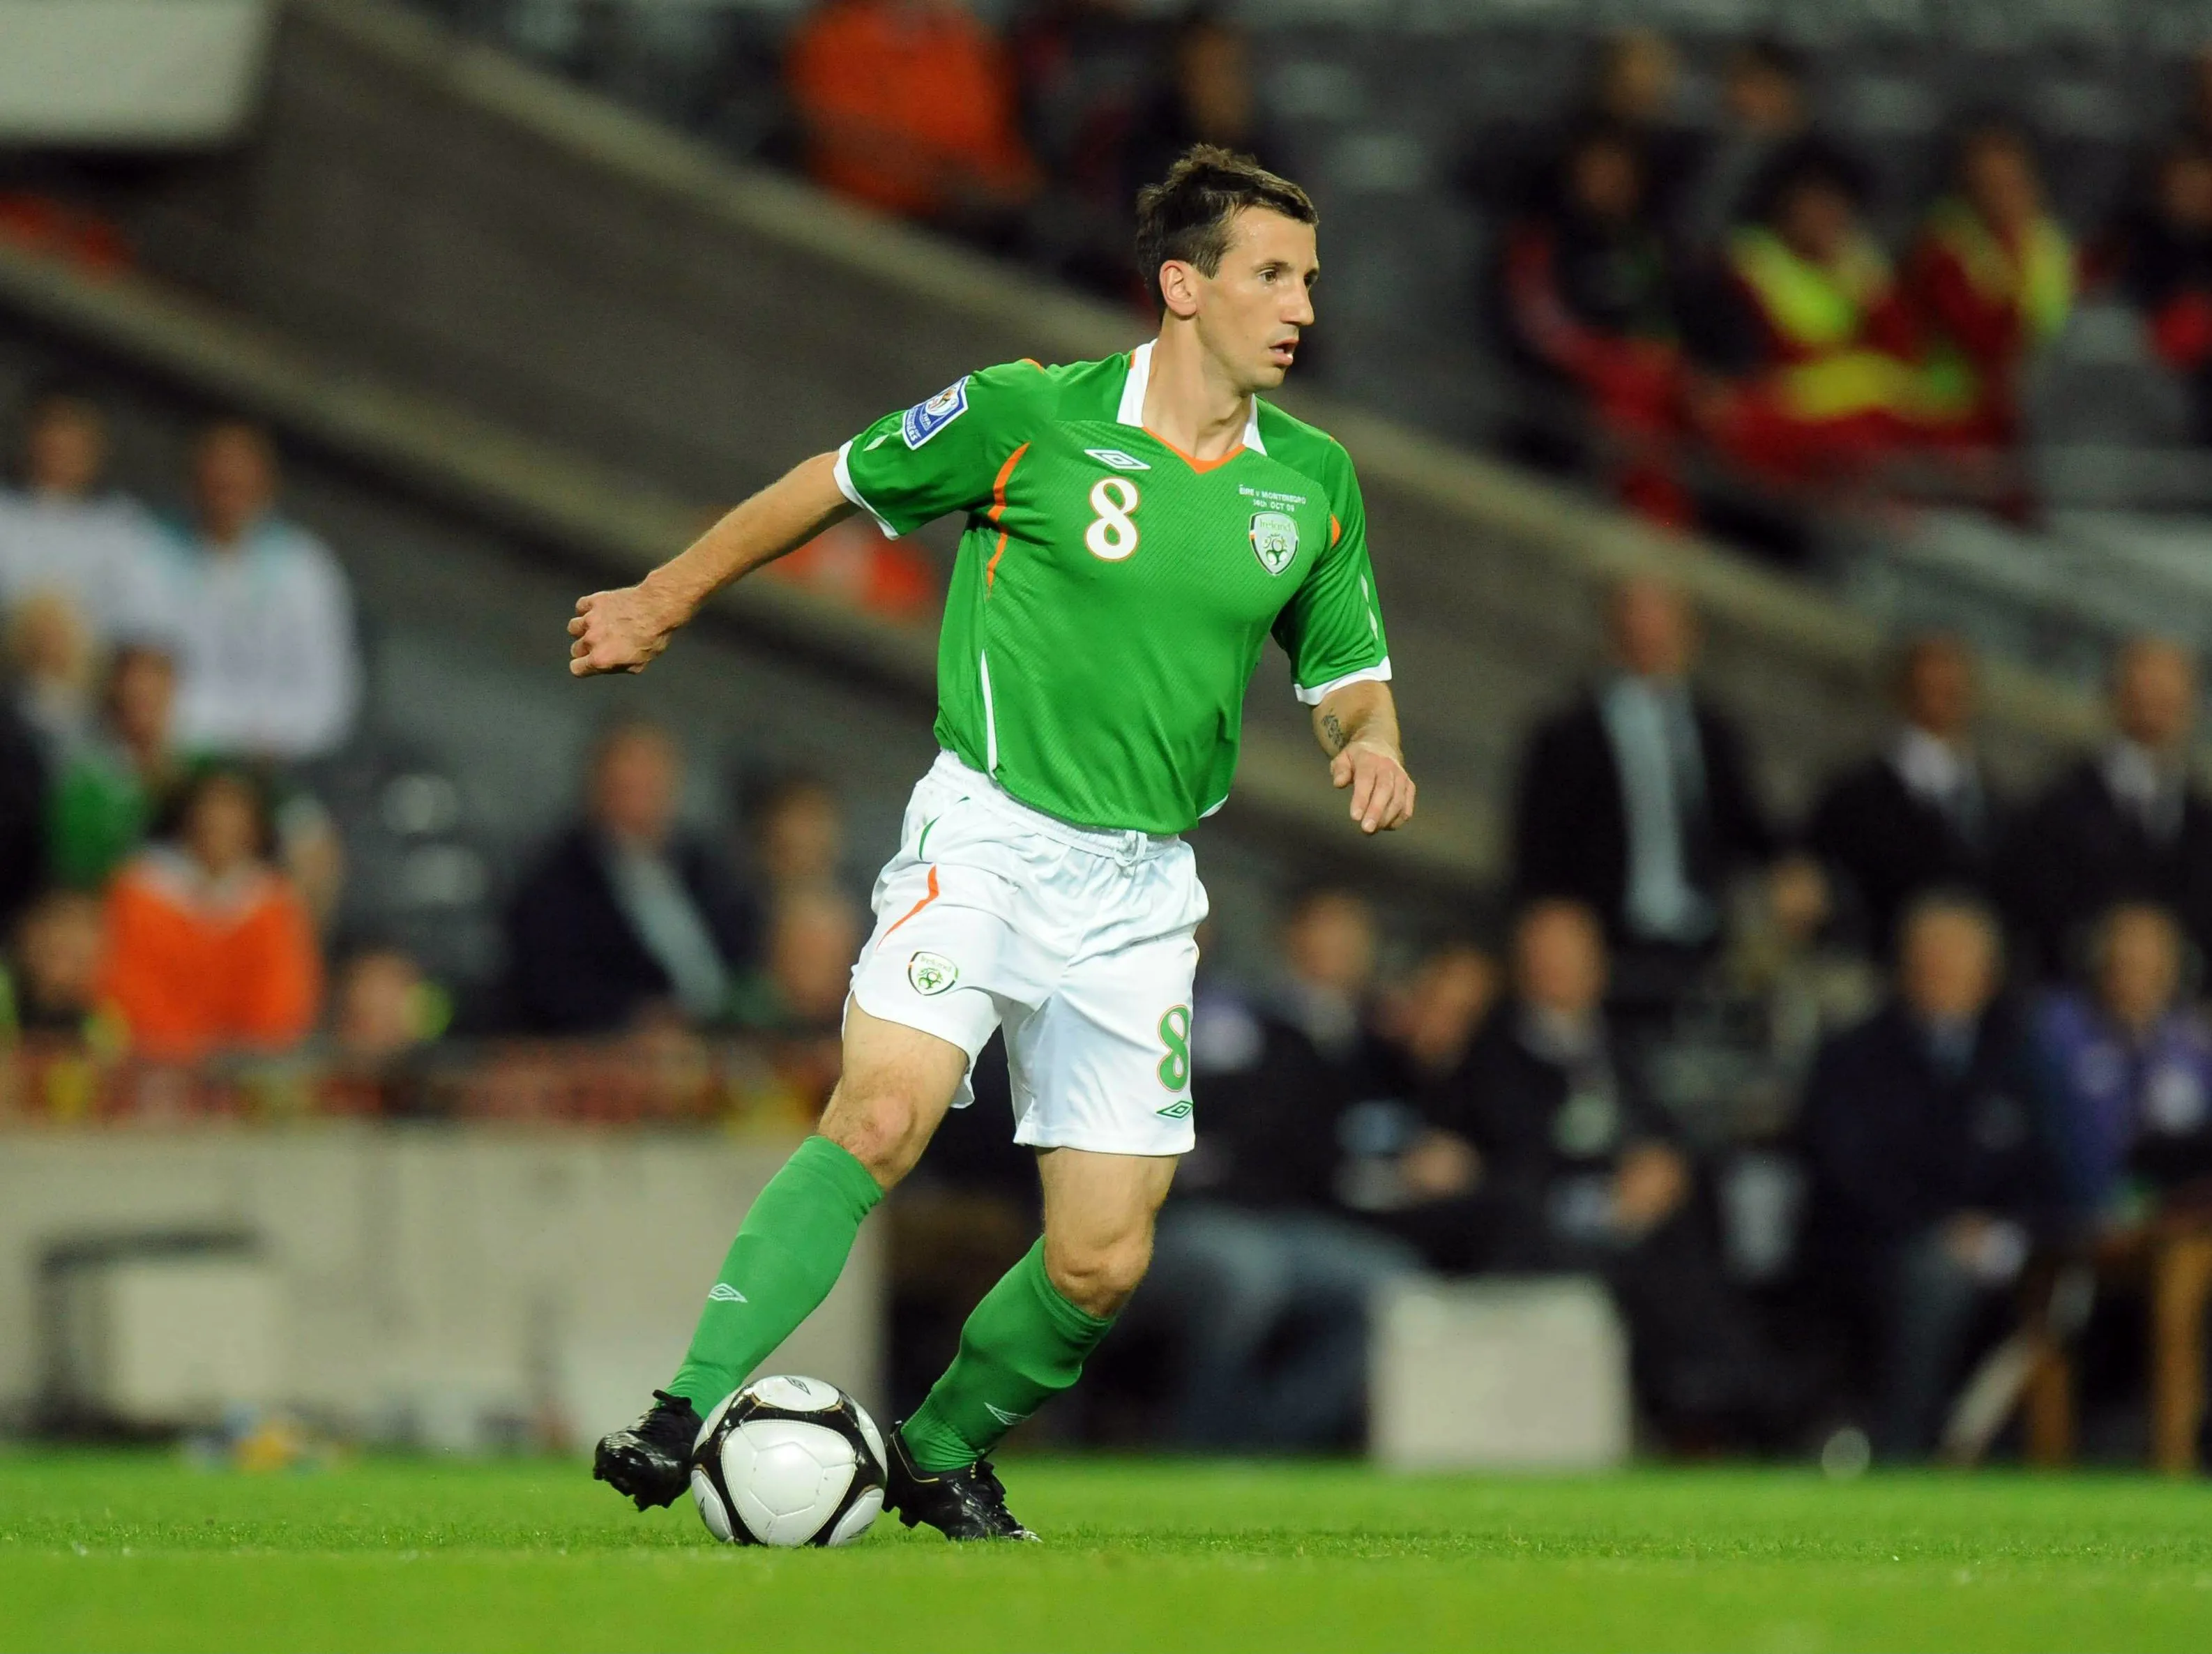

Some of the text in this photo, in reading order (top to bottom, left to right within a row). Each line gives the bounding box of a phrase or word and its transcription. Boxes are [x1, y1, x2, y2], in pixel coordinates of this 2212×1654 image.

[1084, 476, 1141, 563] 8
[1270, 501, 1285, 510] OCT
[1156, 1003, 1190, 1093] 8
